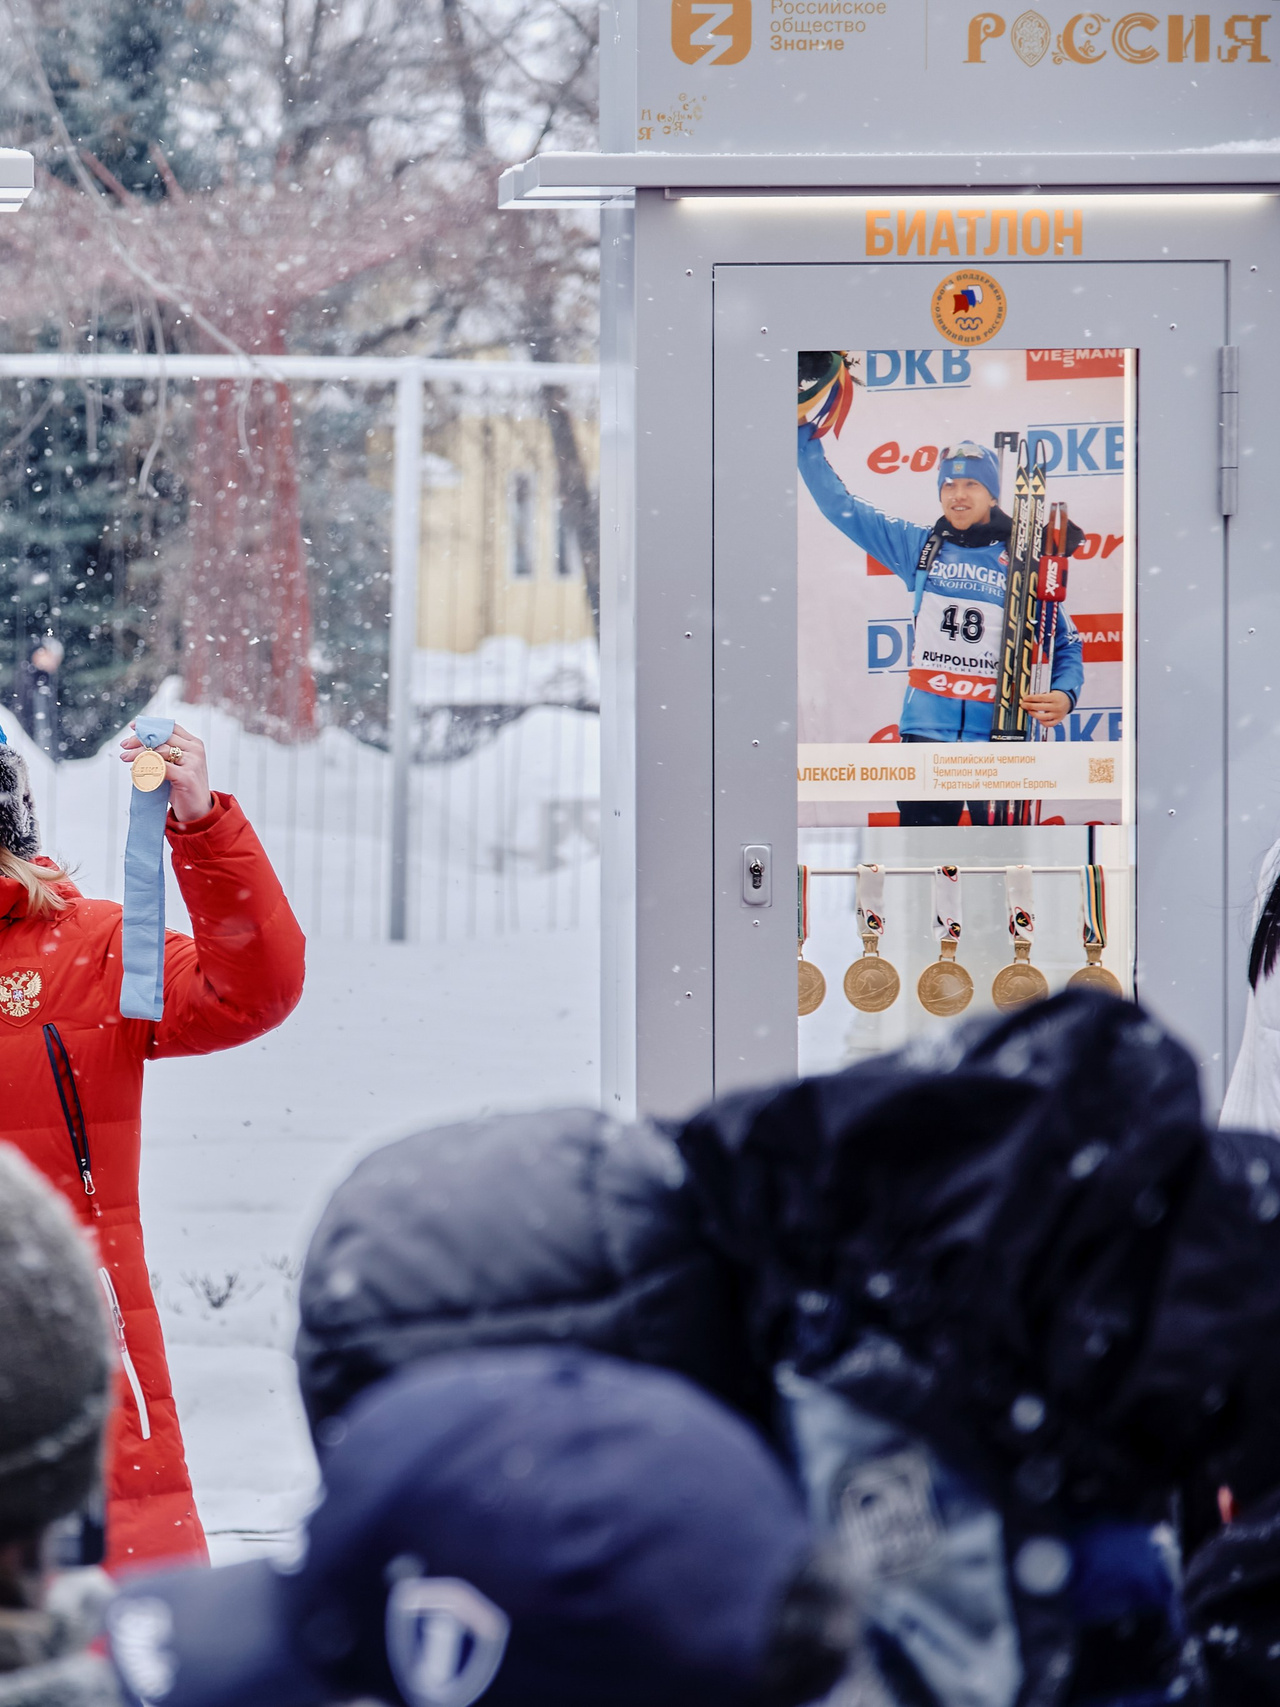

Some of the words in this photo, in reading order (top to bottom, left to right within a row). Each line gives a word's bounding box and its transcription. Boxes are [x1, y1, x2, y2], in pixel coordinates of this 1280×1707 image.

[770, 17, 866, 34] общество
[963, 9, 1272, 68] РОССИЯ
[770, 35, 845, 51] Знание
[865, 208, 1084, 257] БИАТЛОН
[866, 349, 972, 387] DKB
[1015, 498, 1029, 562] FISCHER
[1031, 499, 1045, 562] FISCHER
[929, 560, 1007, 591] ERDINGER
[940, 604, 985, 644] 48
[860, 766, 916, 781] ВОЛКОВ
[933, 754, 995, 765] Олимпийский
[997, 755, 1036, 764] чемпион
[933, 767, 973, 777] Чемпион
[975, 768, 998, 778] мира
[933, 779, 980, 791] 7-кратный
[982, 780, 1021, 790] чемпион
[1023, 778, 1057, 790] Европы
